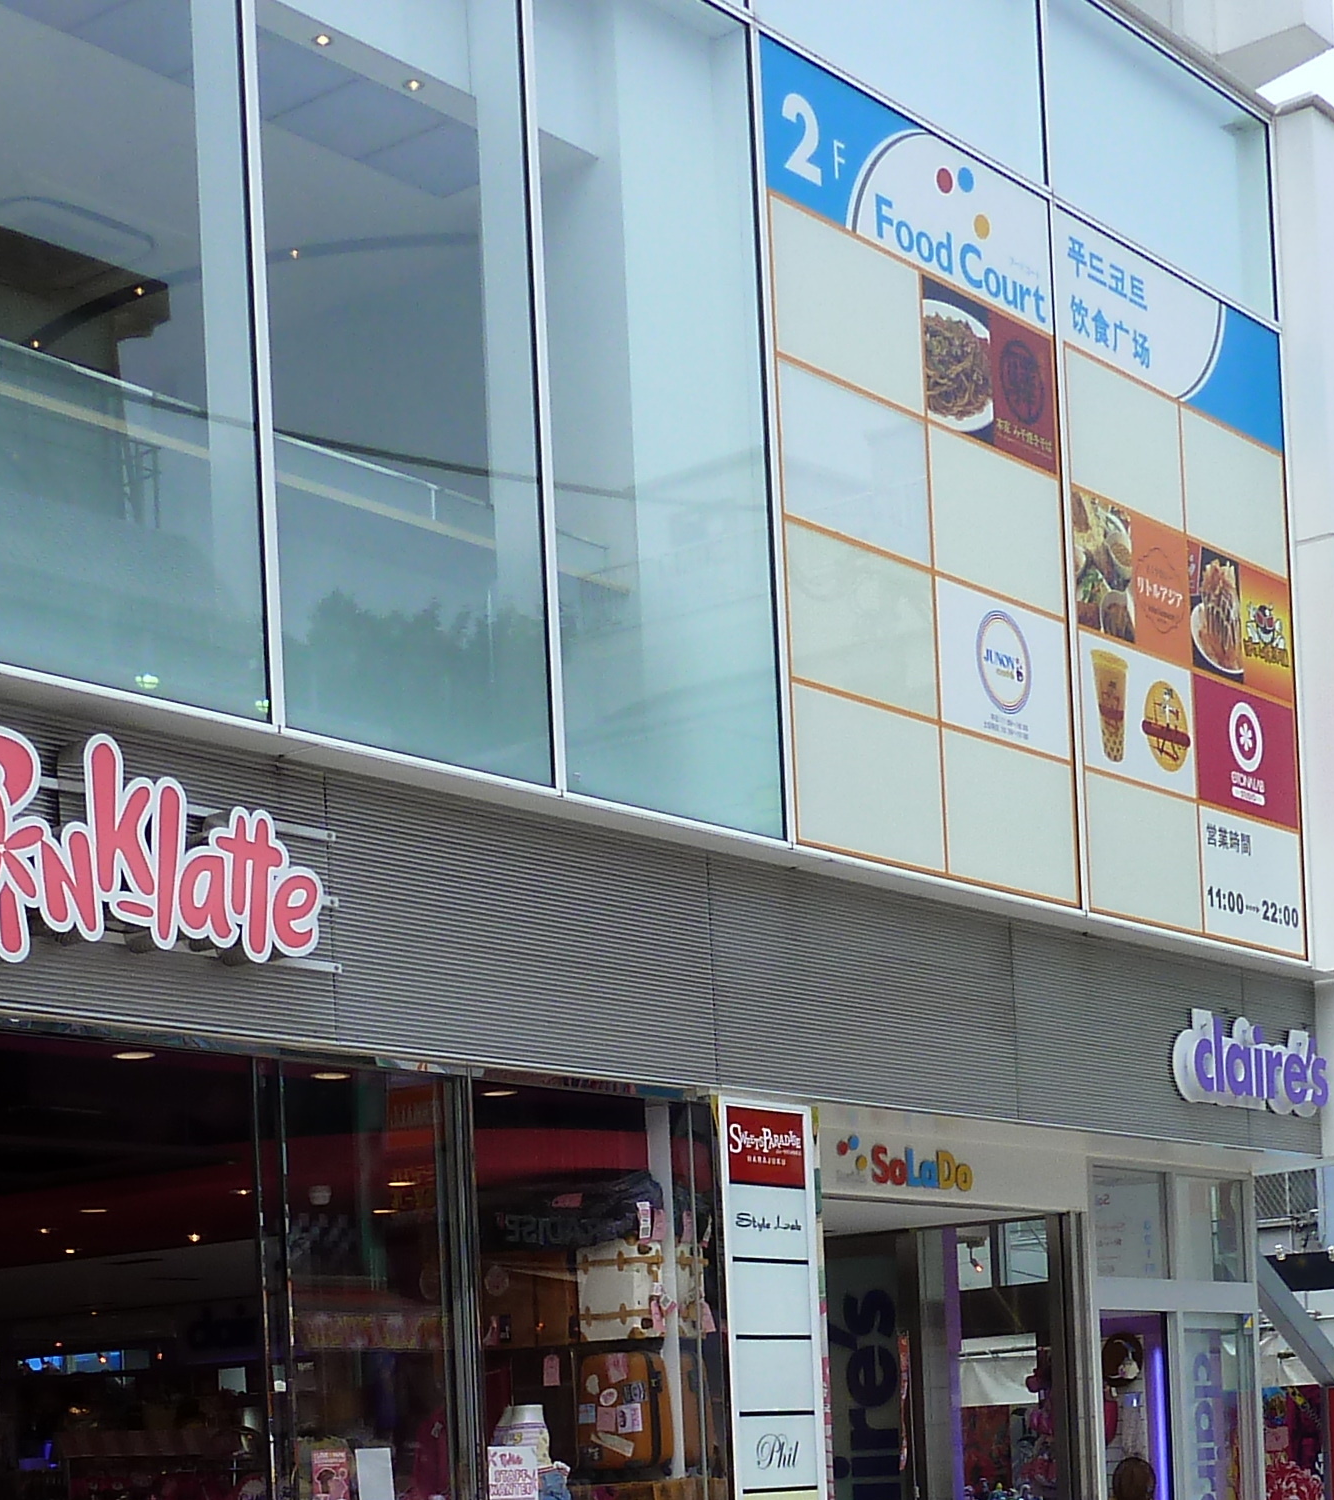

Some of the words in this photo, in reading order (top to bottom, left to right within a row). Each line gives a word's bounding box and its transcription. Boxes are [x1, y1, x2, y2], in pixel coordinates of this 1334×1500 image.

[875, 193, 952, 275] Food
[959, 242, 1047, 325] Court
[1067, 235, 1148, 313] 푸드코트
[1070, 294, 1151, 369] 饮食广场
[1206, 823, 1252, 857] 営業時間
[1185, 1010, 1329, 1109] claire's
[747, 1155, 786, 1167] HARAJUKU
[871, 1144, 973, 1192] SoLaDo
[735, 1212, 771, 1233] Style
[774, 1215, 802, 1231] Lab
[756, 1434, 799, 1470] Phil
[490, 1483, 534, 1498] WANTED
